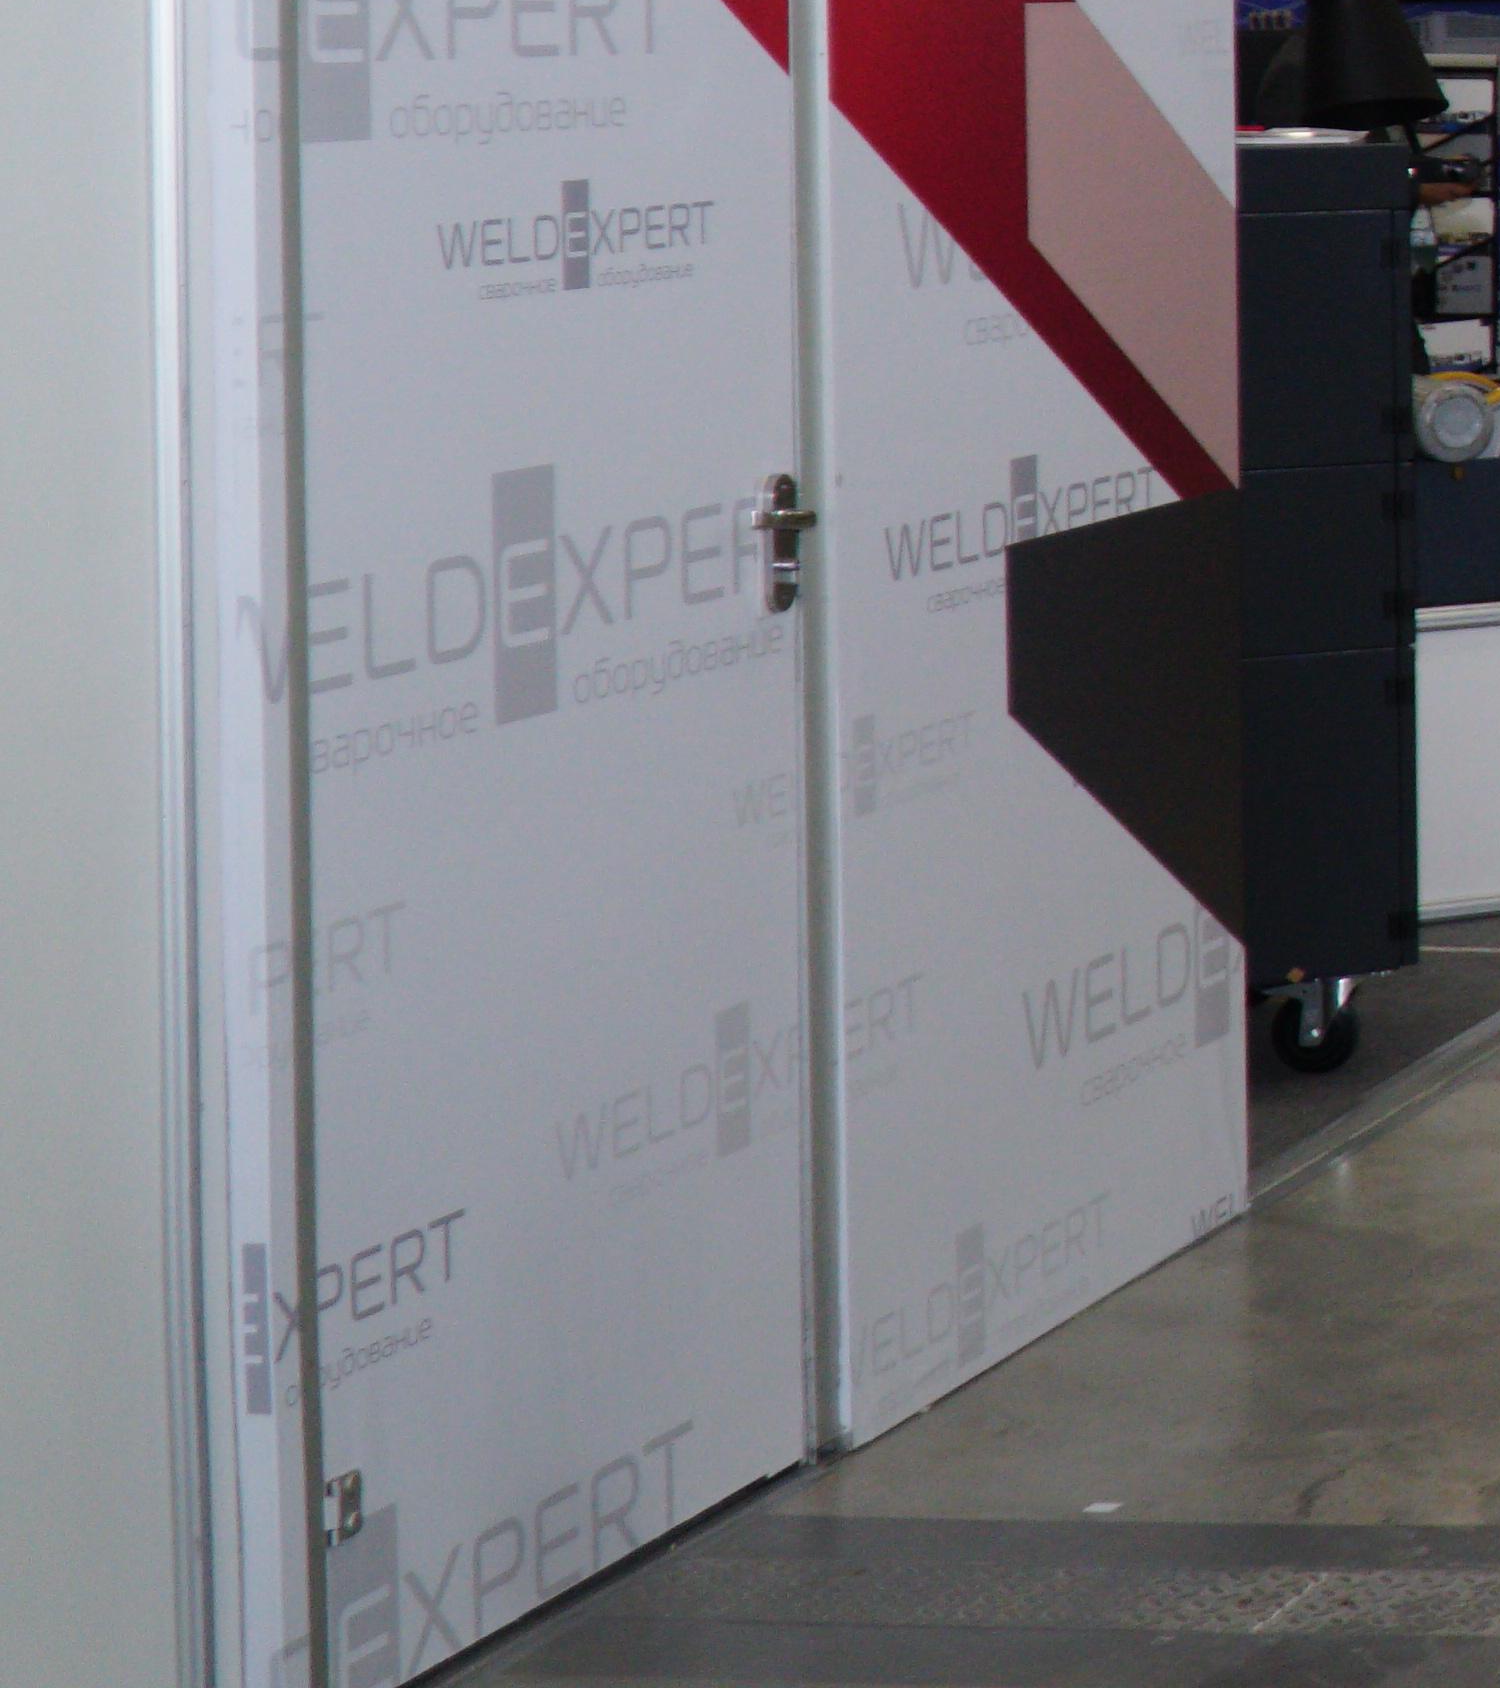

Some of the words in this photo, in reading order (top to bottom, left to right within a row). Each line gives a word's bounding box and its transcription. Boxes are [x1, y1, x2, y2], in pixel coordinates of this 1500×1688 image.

[389, 91, 626, 146] оборудование
[435, 200, 715, 271] WELDEXPERT
[478, 276, 557, 301] сварочное
[598, 261, 694, 289] оборудование
[573, 620, 786, 706] оборудование
[310, 700, 479, 775] варочное
